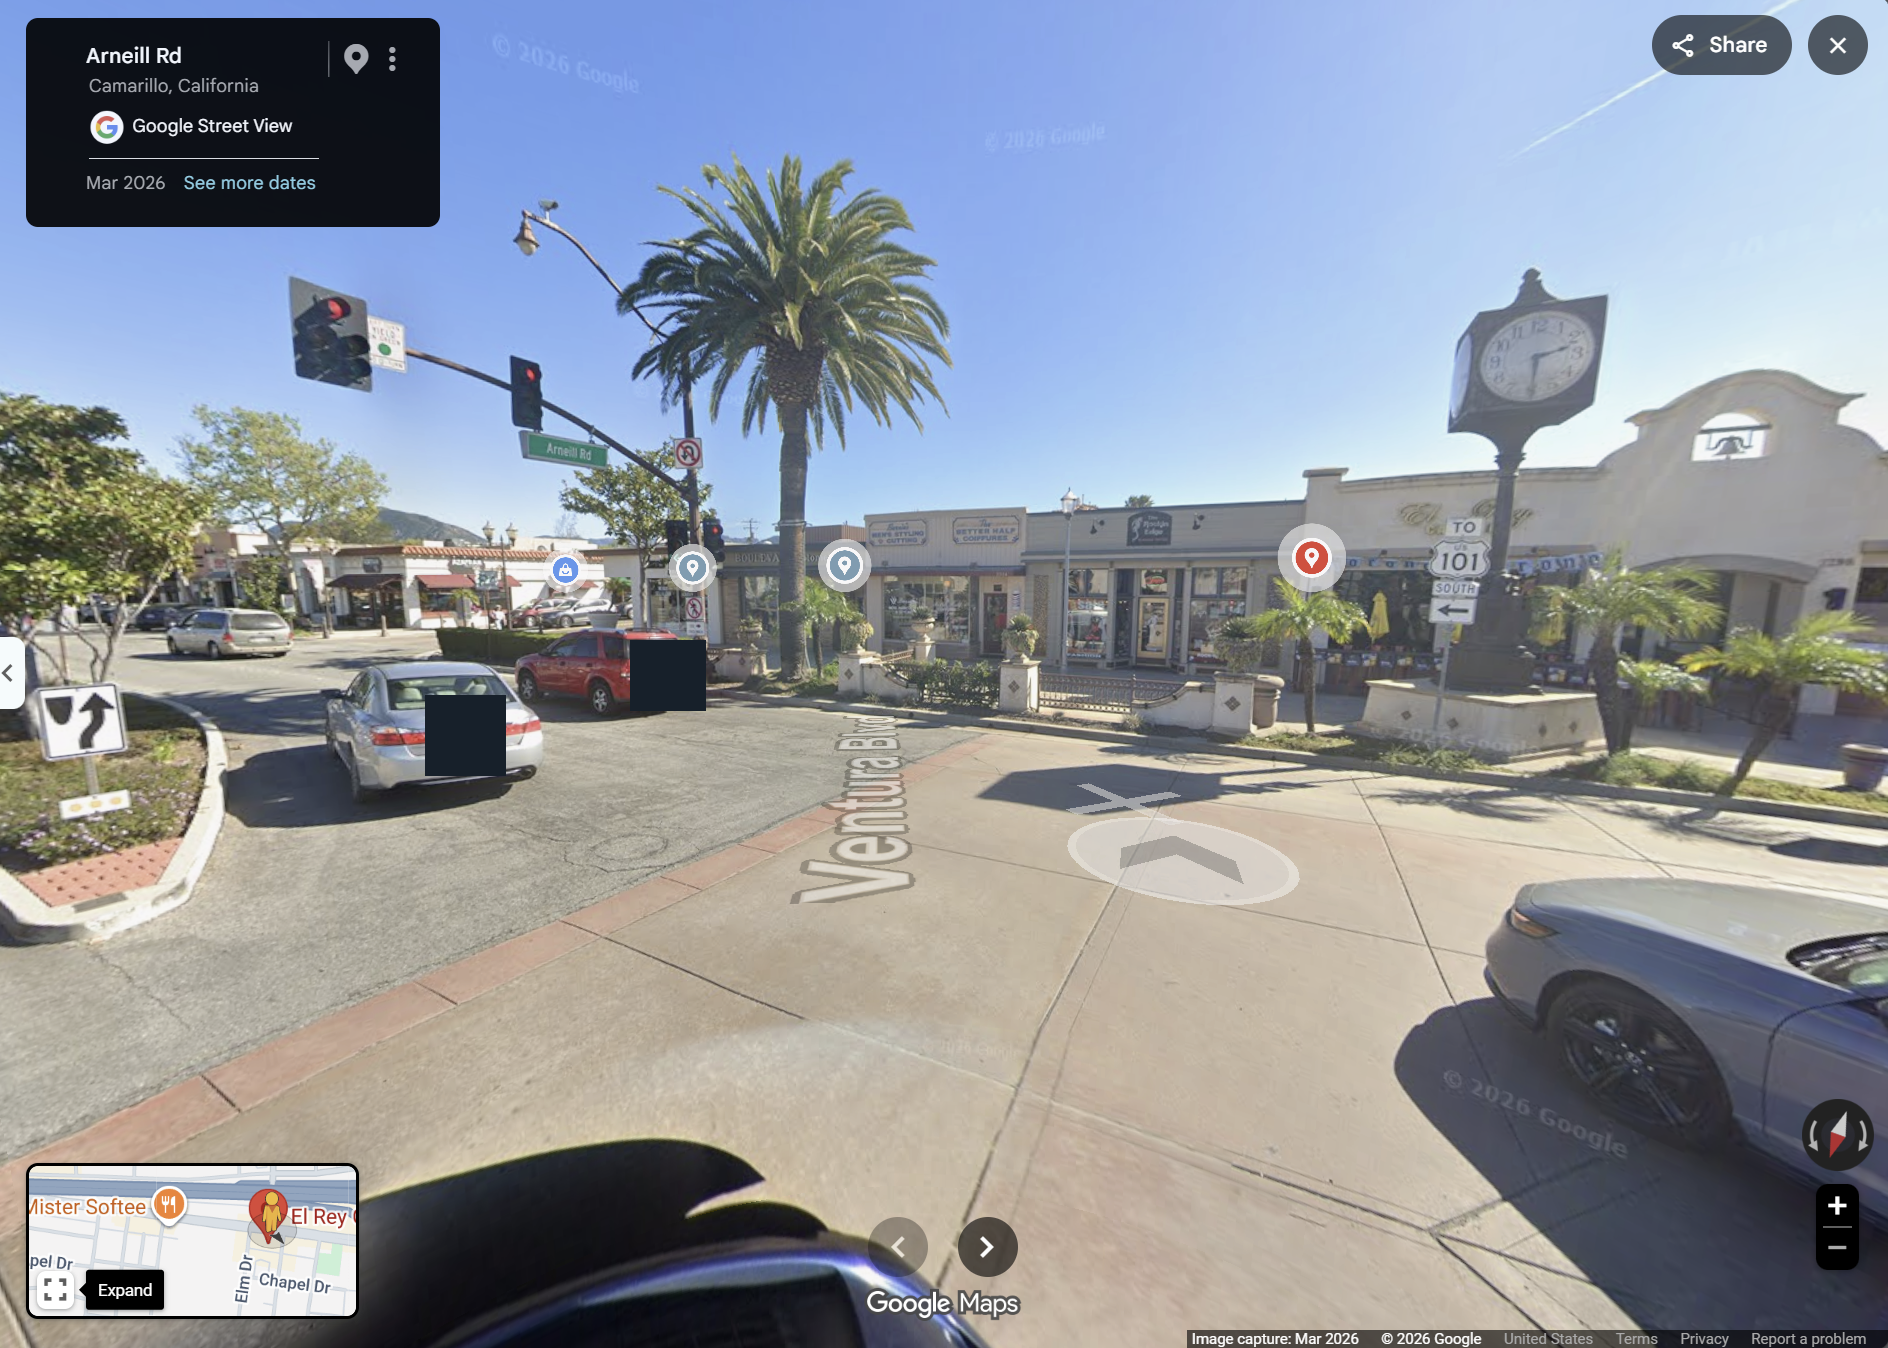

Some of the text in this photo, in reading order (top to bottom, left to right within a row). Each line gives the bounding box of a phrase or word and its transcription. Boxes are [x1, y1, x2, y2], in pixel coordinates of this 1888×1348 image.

[546, 442, 592, 461] Arneill Rd
[1453, 521, 1476, 533] TO
[894, 530, 925, 538] STYLING
[1442, 552, 1478, 571] 101
[1435, 583, 1476, 594] SOUTH
